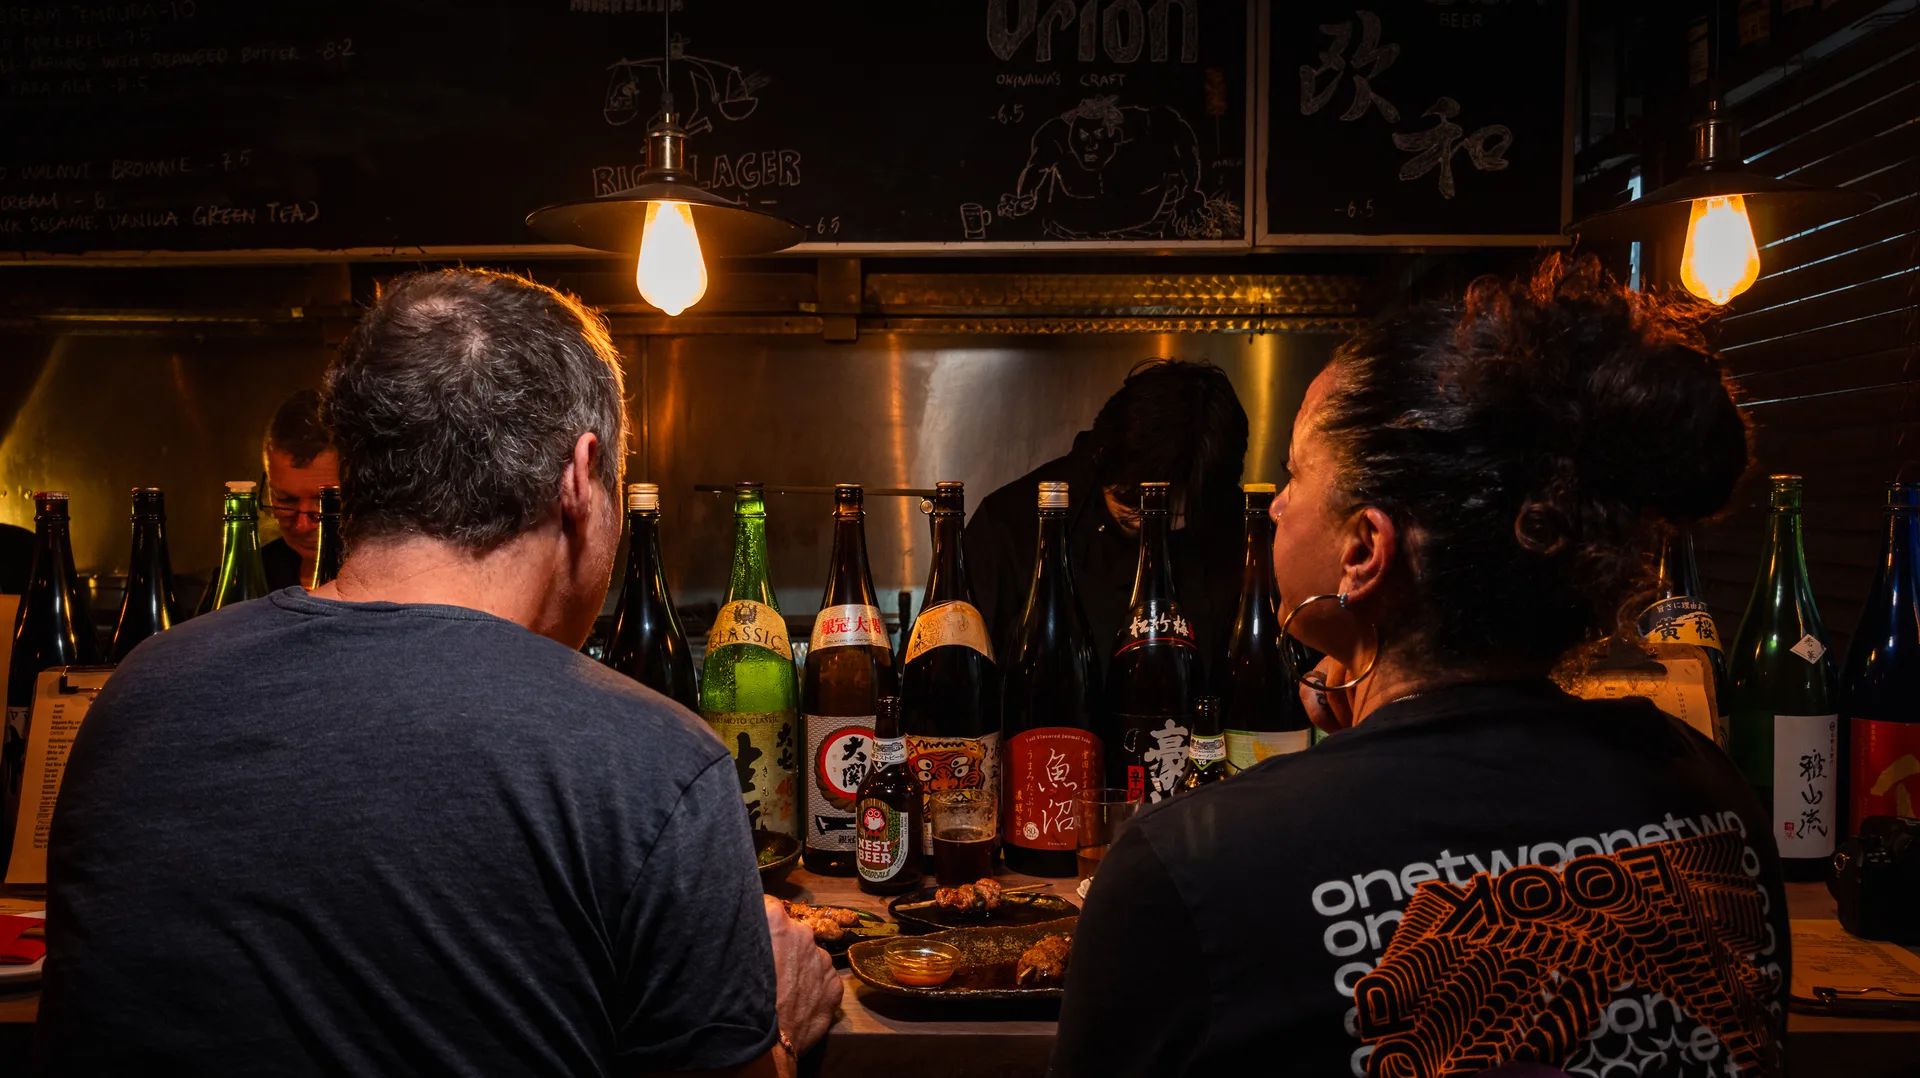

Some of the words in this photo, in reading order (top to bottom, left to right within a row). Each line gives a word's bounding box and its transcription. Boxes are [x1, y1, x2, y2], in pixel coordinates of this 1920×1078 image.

[1438, 12, 1484, 29] BEER
[1079, 73, 1126, 88] CRAFT
[111, 156, 194, 181] BROWNIE
[191, 205, 257, 227] GREEN
[1129, 612, 1190, 638] 松竹梅
[709, 625, 783, 651] CLASSIC
[1037, 747, 1078, 835] 魚沼
[858, 848, 893, 864] BEER
[859, 838, 891, 852] NEST
